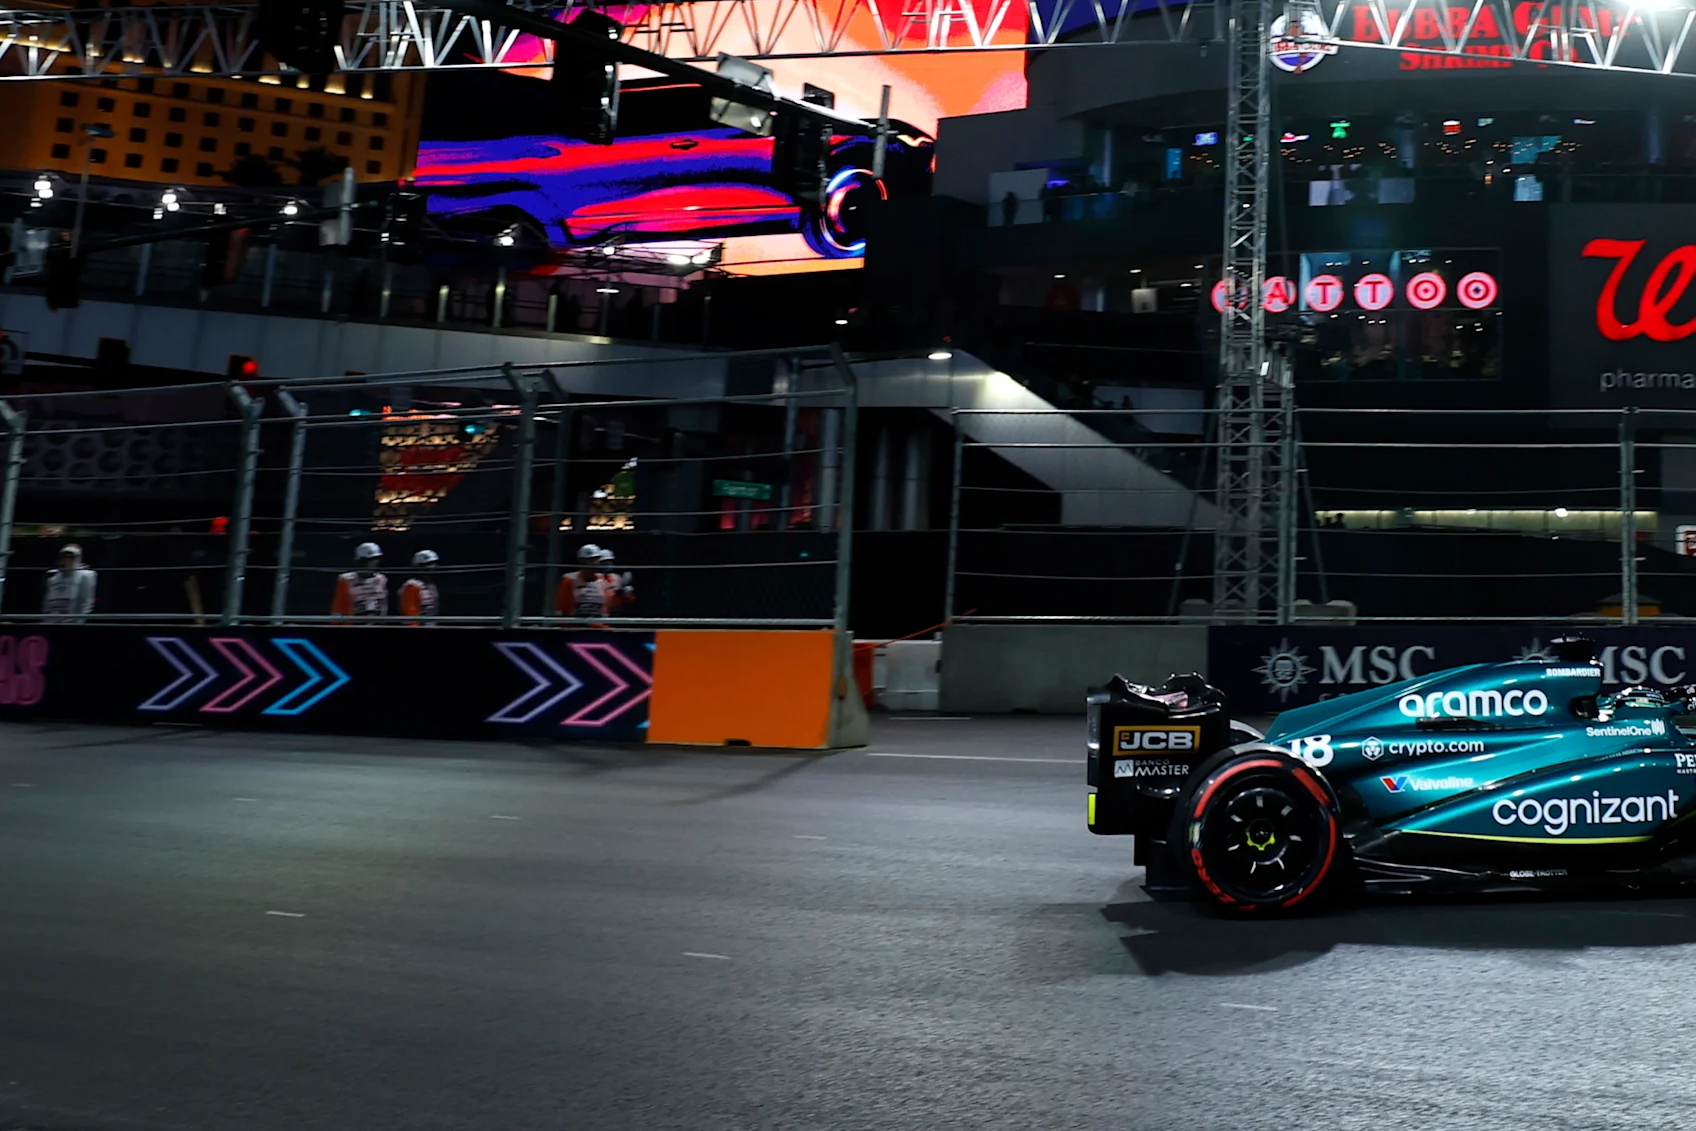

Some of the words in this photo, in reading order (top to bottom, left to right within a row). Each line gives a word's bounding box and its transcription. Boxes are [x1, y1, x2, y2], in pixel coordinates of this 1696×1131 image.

[1318, 645, 1436, 685] MSC
[1546, 668, 1601, 677] BOMBARDIER
[1398, 688, 1548, 718] aramco
[1586, 725, 1652, 737] SentinelOne
[1119, 731, 1194, 751] JCB
[1388, 737, 1485, 756] crypto.com
[1287, 734, 1335, 768] 18
[1134, 759, 1171, 767] BANCO
[1134, 764, 1190, 777] MASTER
[1410, 776, 1474, 792] Valvoline
[1492, 789, 1680, 836] cognizant
